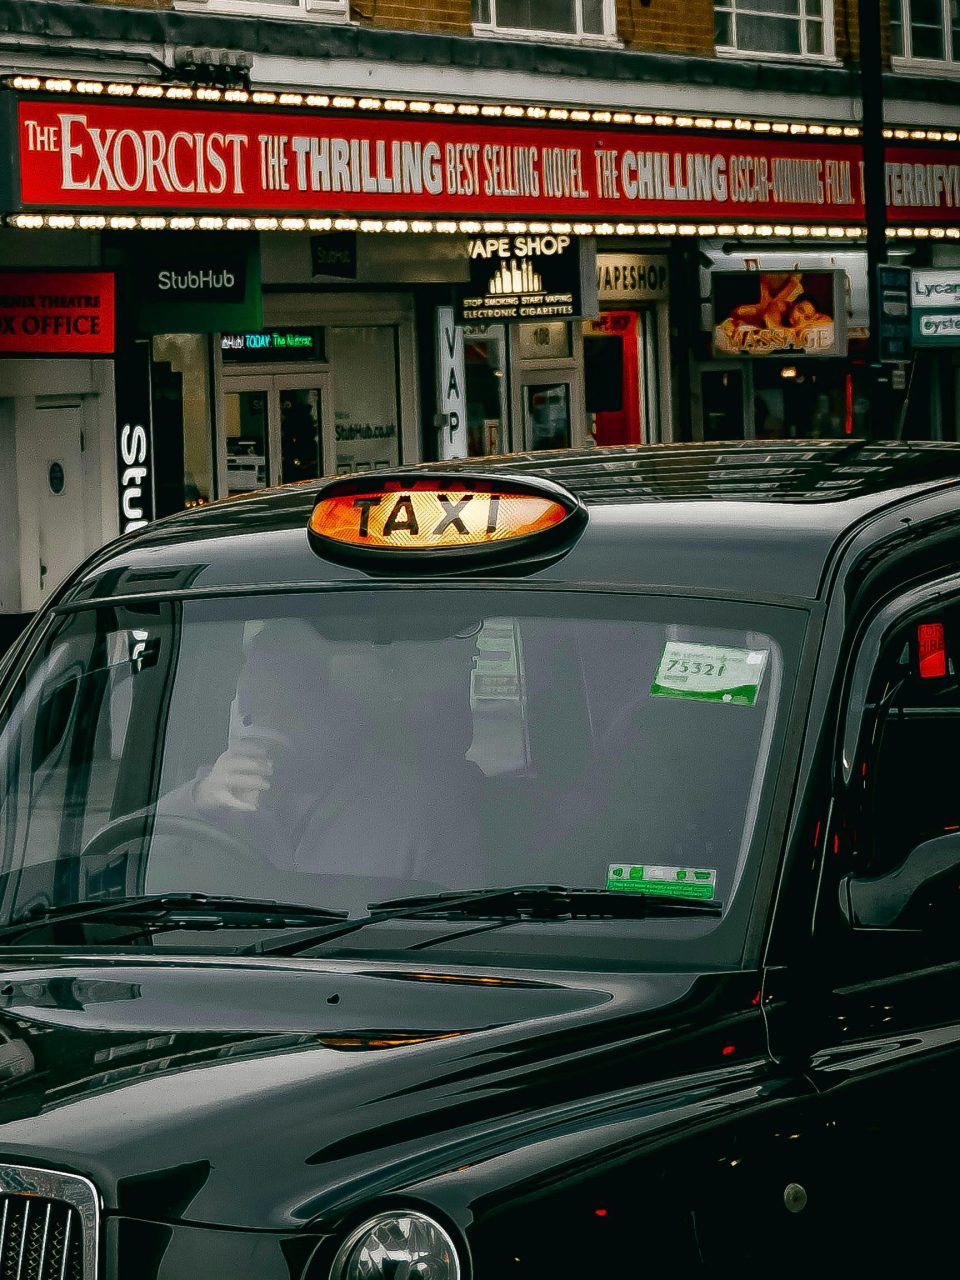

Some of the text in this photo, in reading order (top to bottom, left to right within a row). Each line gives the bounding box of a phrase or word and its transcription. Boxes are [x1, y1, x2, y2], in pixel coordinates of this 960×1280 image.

[23, 119, 60, 153] THE
[57, 113, 248, 195] EXORCIST
[257, 134, 290, 192] THE
[292, 136, 444, 196] THRILLING
[445, 143, 480, 197] BEST
[482, 144, 539, 198] SELLING
[542, 147, 589, 199] NOVEL
[594, 150, 620, 199] THE
[621, 151, 728, 203] CHILLING
[513, 235, 571, 258] SHOP
[157, 269, 235, 290] StubHub
[40, 295, 101, 309] THEATRE
[463, 298, 483, 308] STOP
[484, 296, 520, 306] SMOKING
[521, 295, 544, 305] START
[463, 305, 574, 320] ELECTRONIC CIGARETTES
[22, 315, 102, 336] OFFICE
[725, 328, 834, 351] MASSAGE
[444, 327, 461, 460] VAP
[353, 494, 501, 538] TAXI
